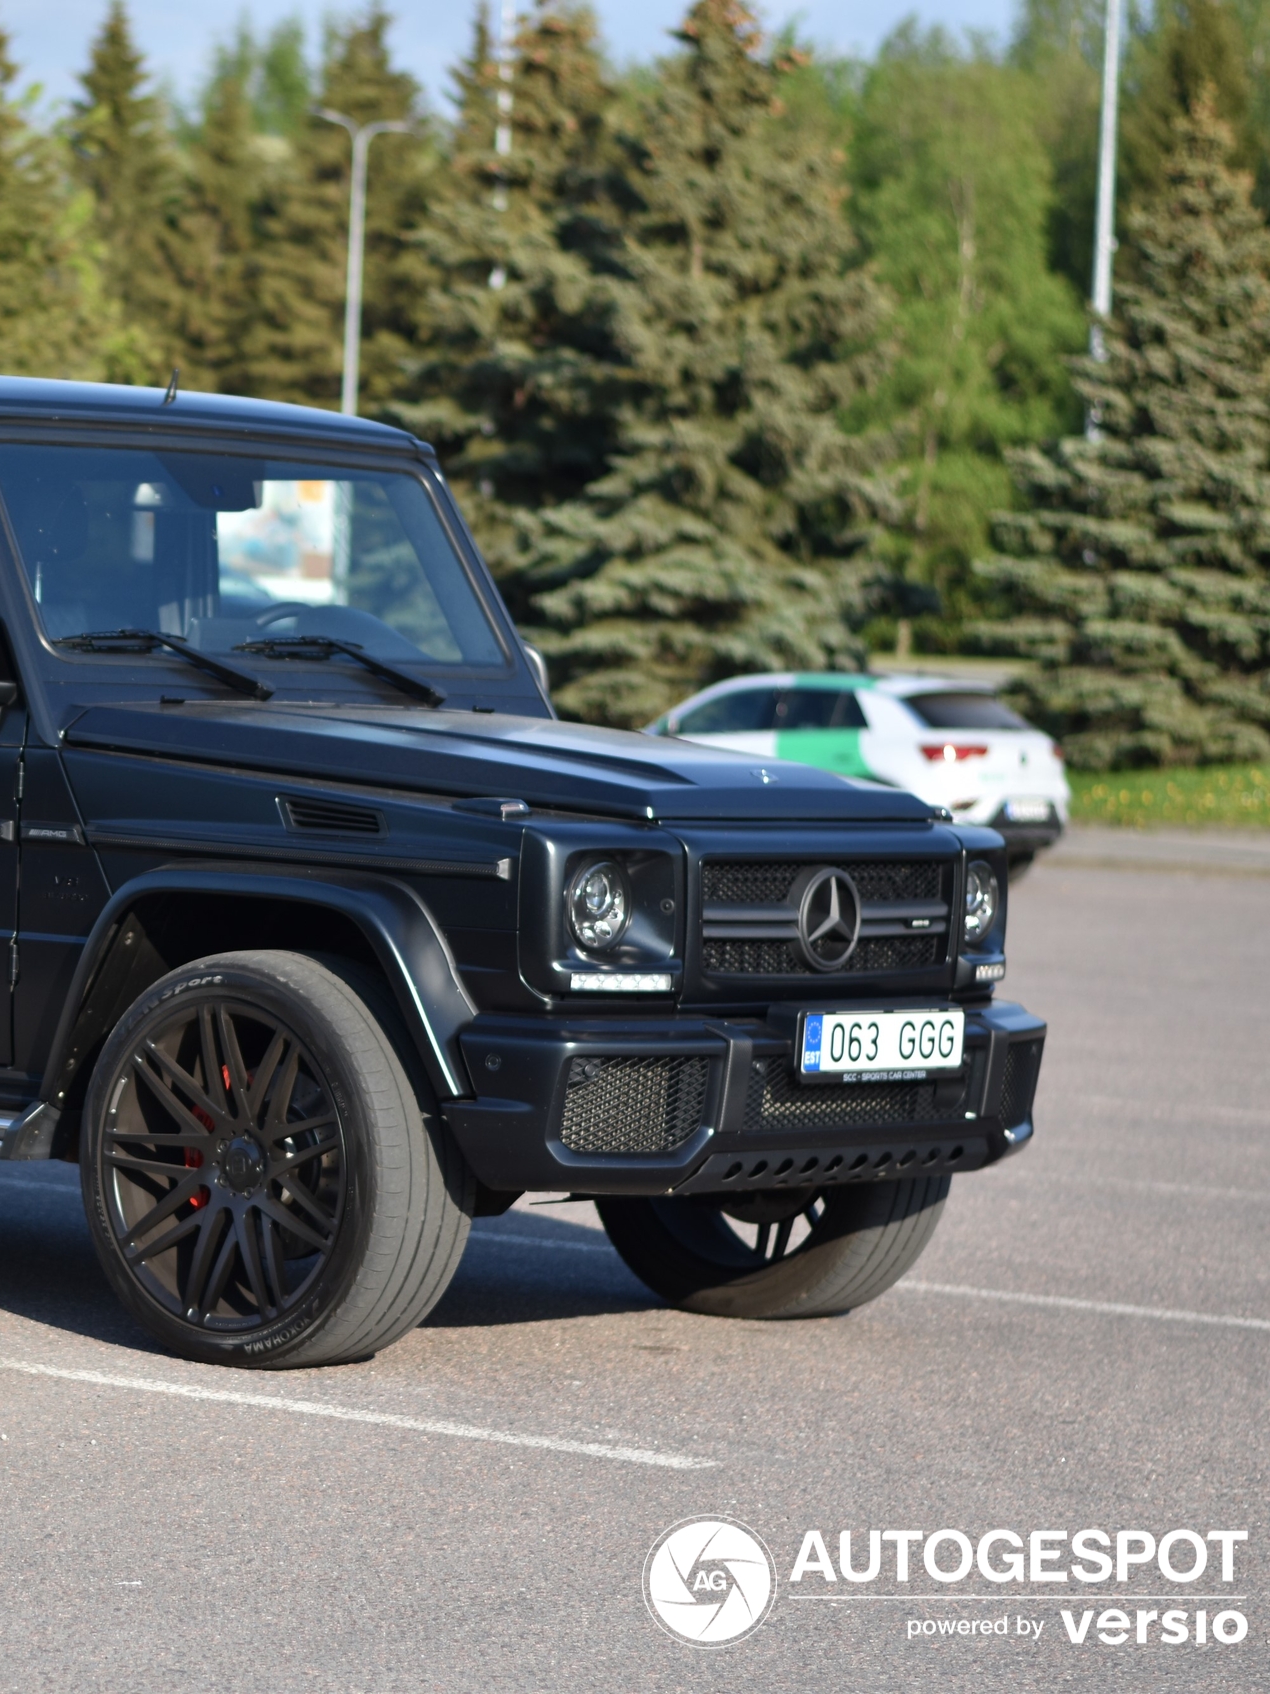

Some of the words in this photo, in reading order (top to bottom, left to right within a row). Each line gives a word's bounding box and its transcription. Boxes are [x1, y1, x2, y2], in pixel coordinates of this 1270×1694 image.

[40, 829, 67, 838] AMG
[829, 1021, 880, 1063] 063
[898, 1019, 955, 1060] GGG
[804, 1051, 820, 1065] EST
[843, 1073, 857, 1082] SCC
[861, 1072, 888, 1081] SPORTS
[888, 1071, 902, 1080] CAR
[902, 1070, 927, 1080] CENTER
[243, 1316, 311, 1355] YOKOHAMA
